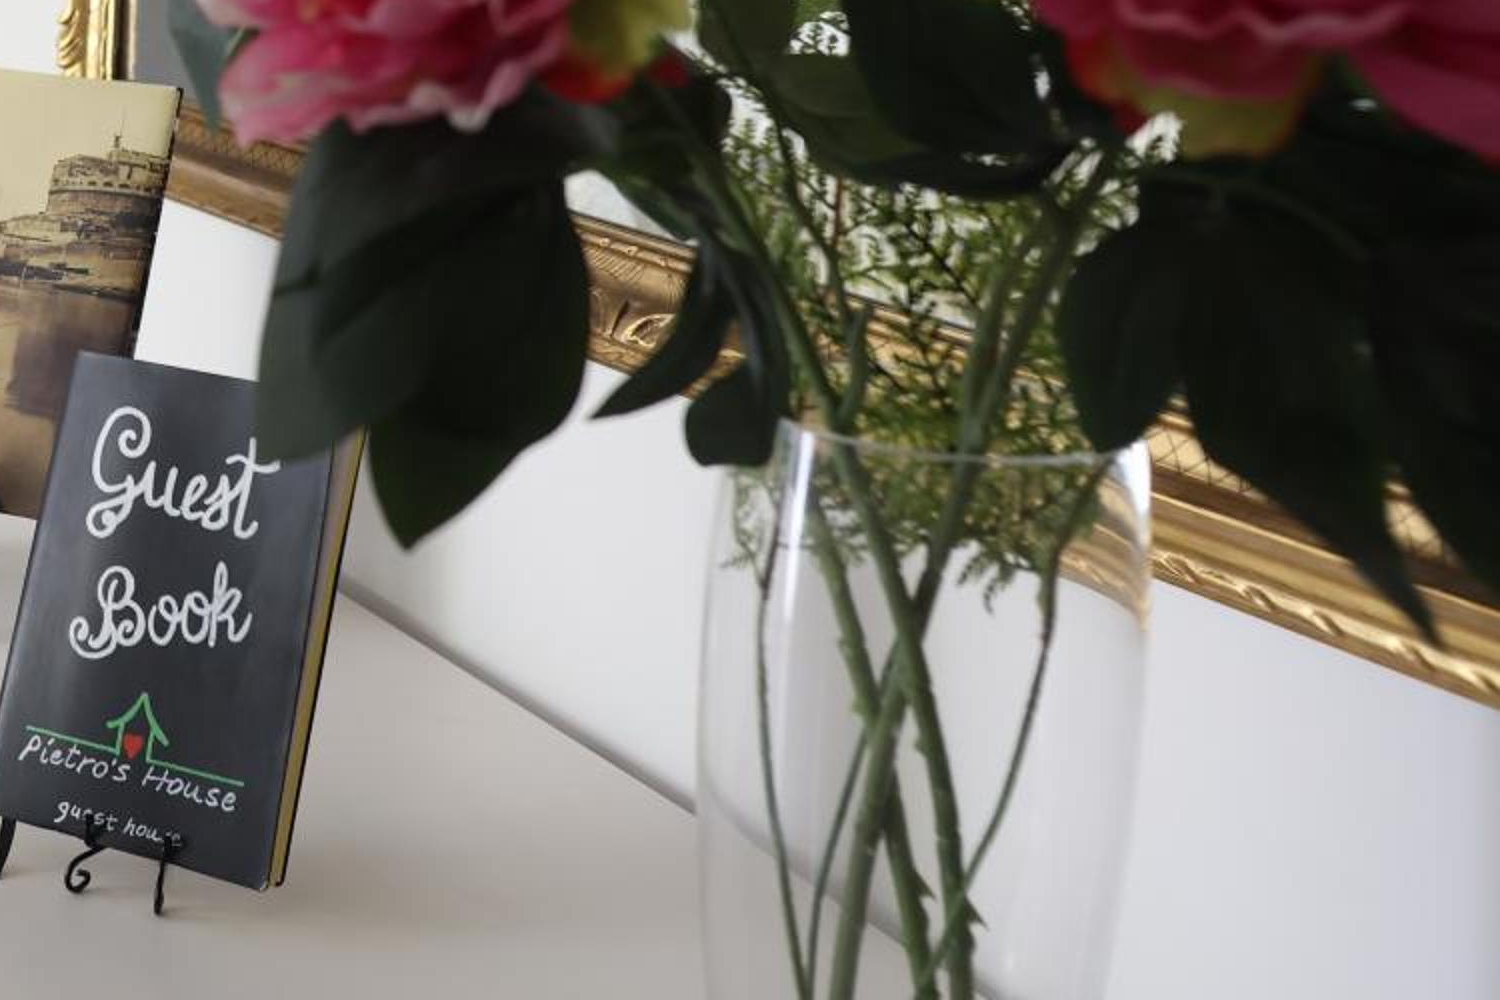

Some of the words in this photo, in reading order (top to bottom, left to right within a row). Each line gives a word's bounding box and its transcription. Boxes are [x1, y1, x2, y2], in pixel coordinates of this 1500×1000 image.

[85, 405, 281, 539] Guest
[68, 561, 252, 660] Book
[18, 734, 131, 782] Pietro's
[141, 764, 238, 813] House
[123, 816, 182, 847] houe
